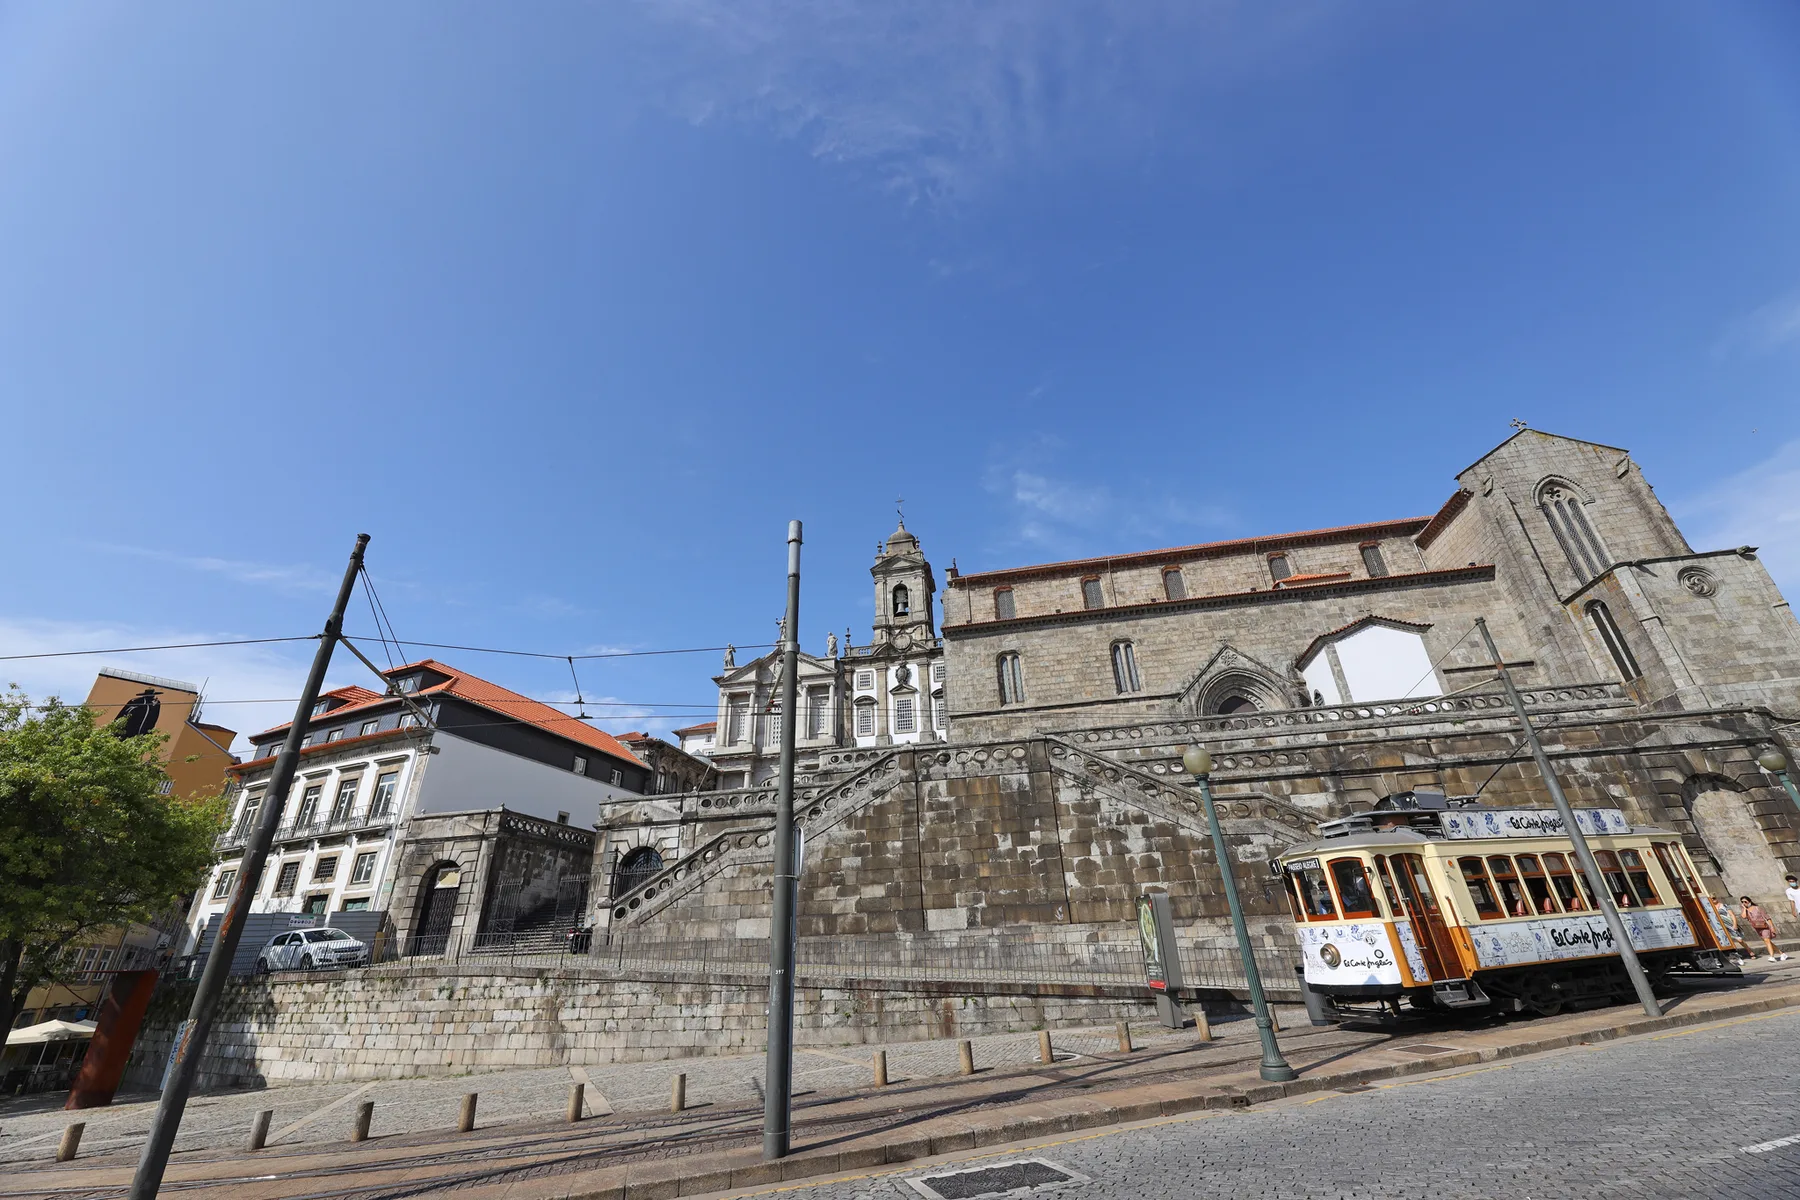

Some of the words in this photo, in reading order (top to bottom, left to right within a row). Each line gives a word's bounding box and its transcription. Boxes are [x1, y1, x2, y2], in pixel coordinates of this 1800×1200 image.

[1510, 816, 1521, 829] El
[1520, 817, 1539, 829] Corte
[1537, 814, 1564, 833] Inglé
[1272, 862, 1278, 873] 1
[1551, 928, 1566, 947] El
[1564, 928, 1591, 946] Corte
[1586, 921, 1614, 949] Ingl
[1343, 959, 1350, 967] El
[1350, 959, 1366, 967] Corte
